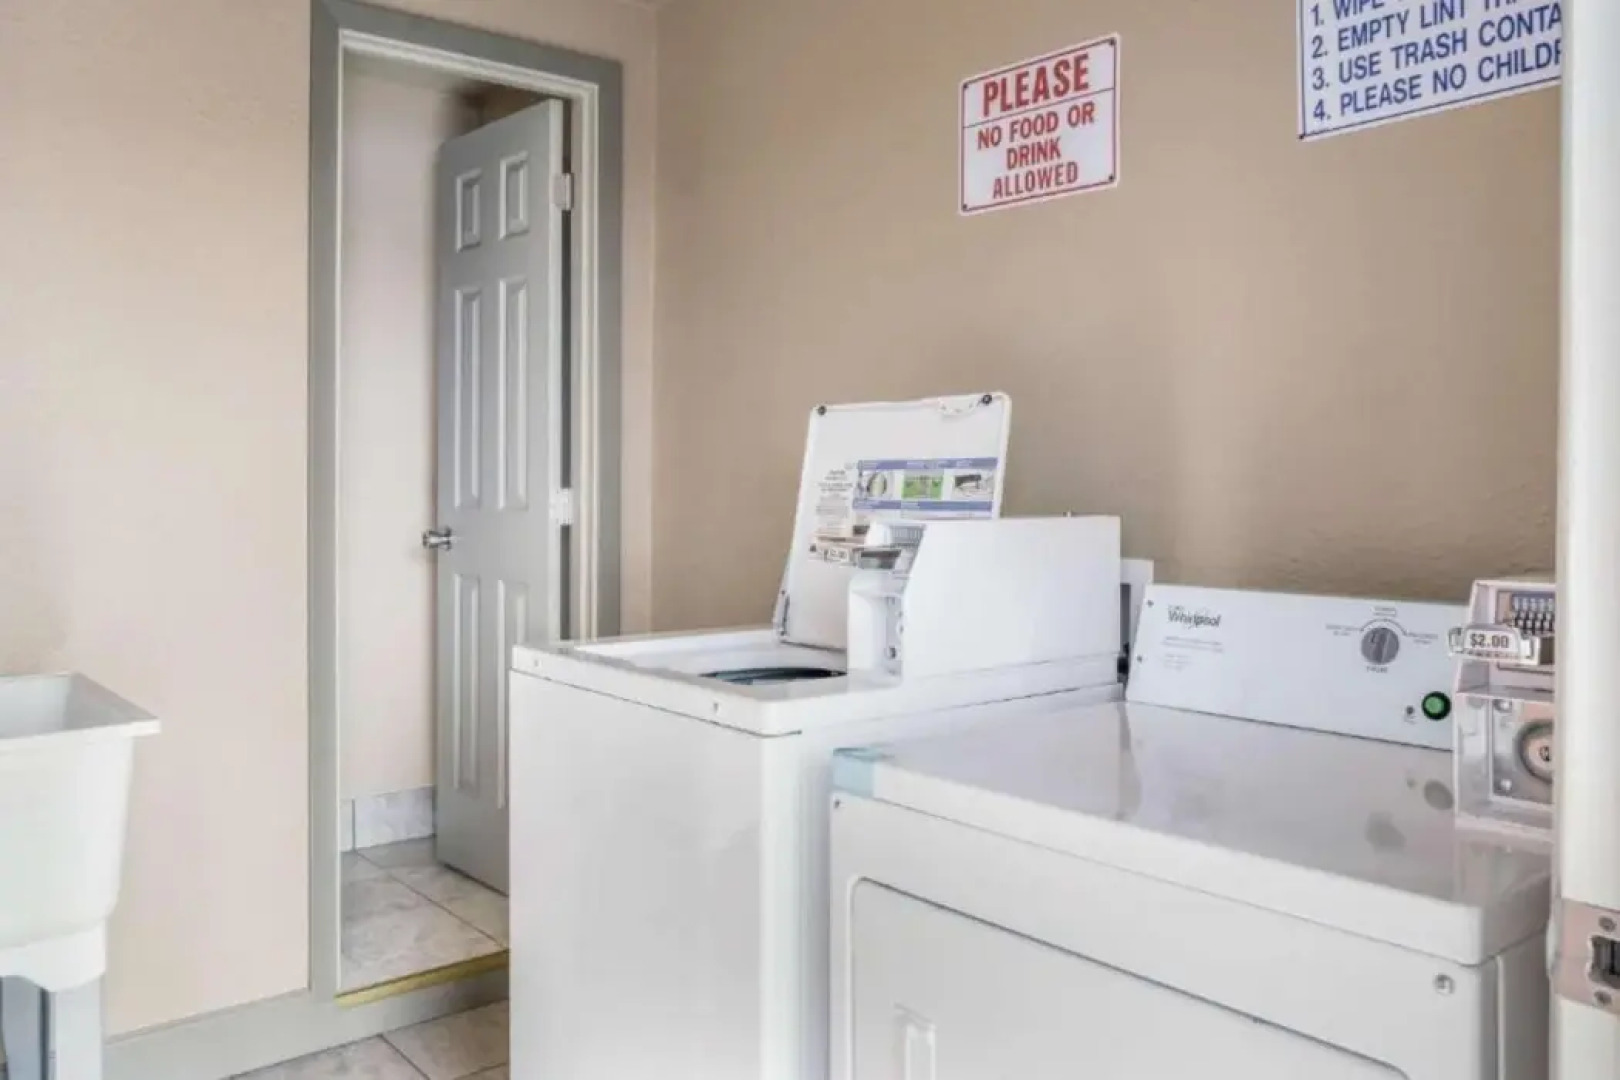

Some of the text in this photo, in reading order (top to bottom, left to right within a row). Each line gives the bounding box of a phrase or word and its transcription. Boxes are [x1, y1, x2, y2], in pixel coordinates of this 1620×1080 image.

[1310, 3, 1325, 26] 1.
[1311, 0, 1465, 59] 2. EMPTY LINT
[1312, 67, 1330, 90] 3.
[1338, 51, 1382, 84] USE
[1390, 28, 1467, 69] TRASH
[983, 53, 1089, 117] PLEASE
[1313, 98, 1331, 120] 4.
[1340, 74, 1422, 117] PLEASE
[1432, 63, 1466, 94] NO
[977, 101, 1095, 150] NO FOOD OR
[1006, 136, 1062, 170] DRINK
[993, 161, 1079, 199] ALLOWED
[1167, 608, 1222, 629] Whirlpool
[1471, 633, 1509, 649] $2.00
